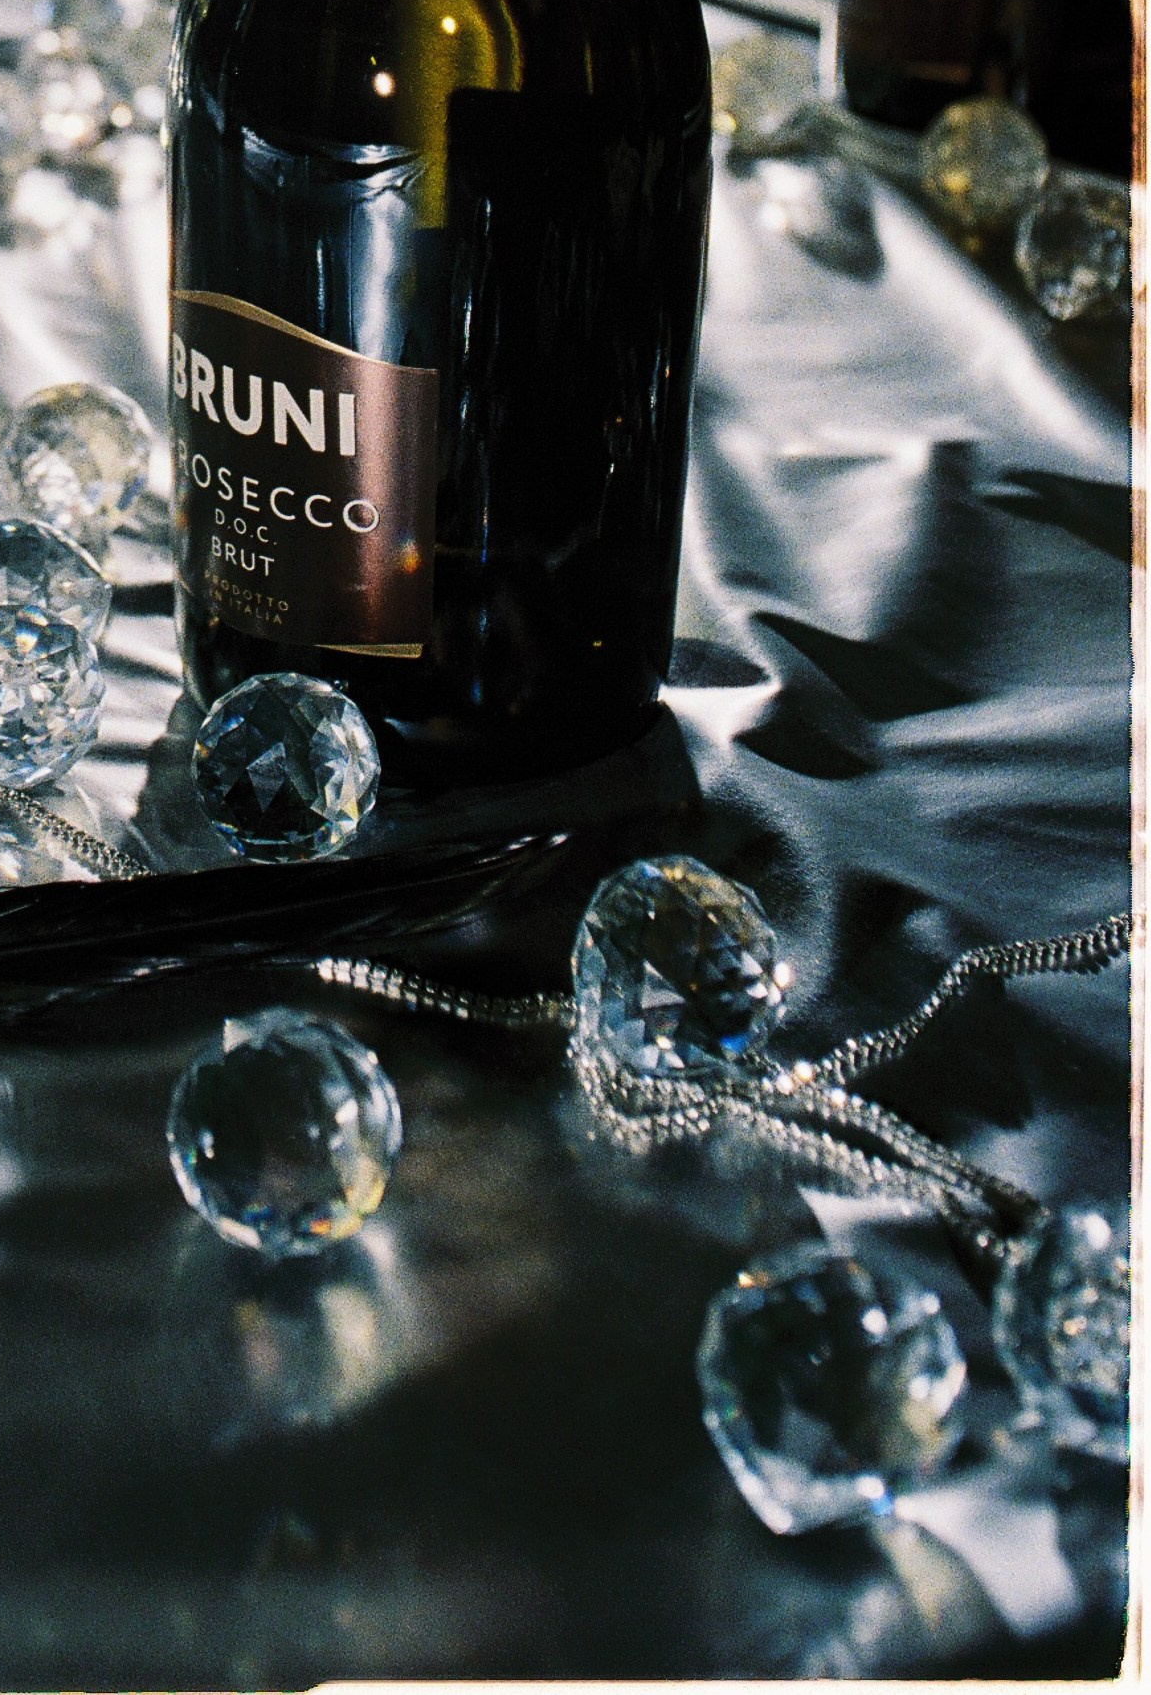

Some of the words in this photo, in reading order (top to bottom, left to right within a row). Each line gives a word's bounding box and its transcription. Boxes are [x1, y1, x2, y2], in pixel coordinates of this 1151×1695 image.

[173, 332, 356, 456] BRUNI
[214, 507, 278, 546] D.O.C.
[211, 535, 275, 577] BRUT
[229, 597, 282, 625] ITALIA
